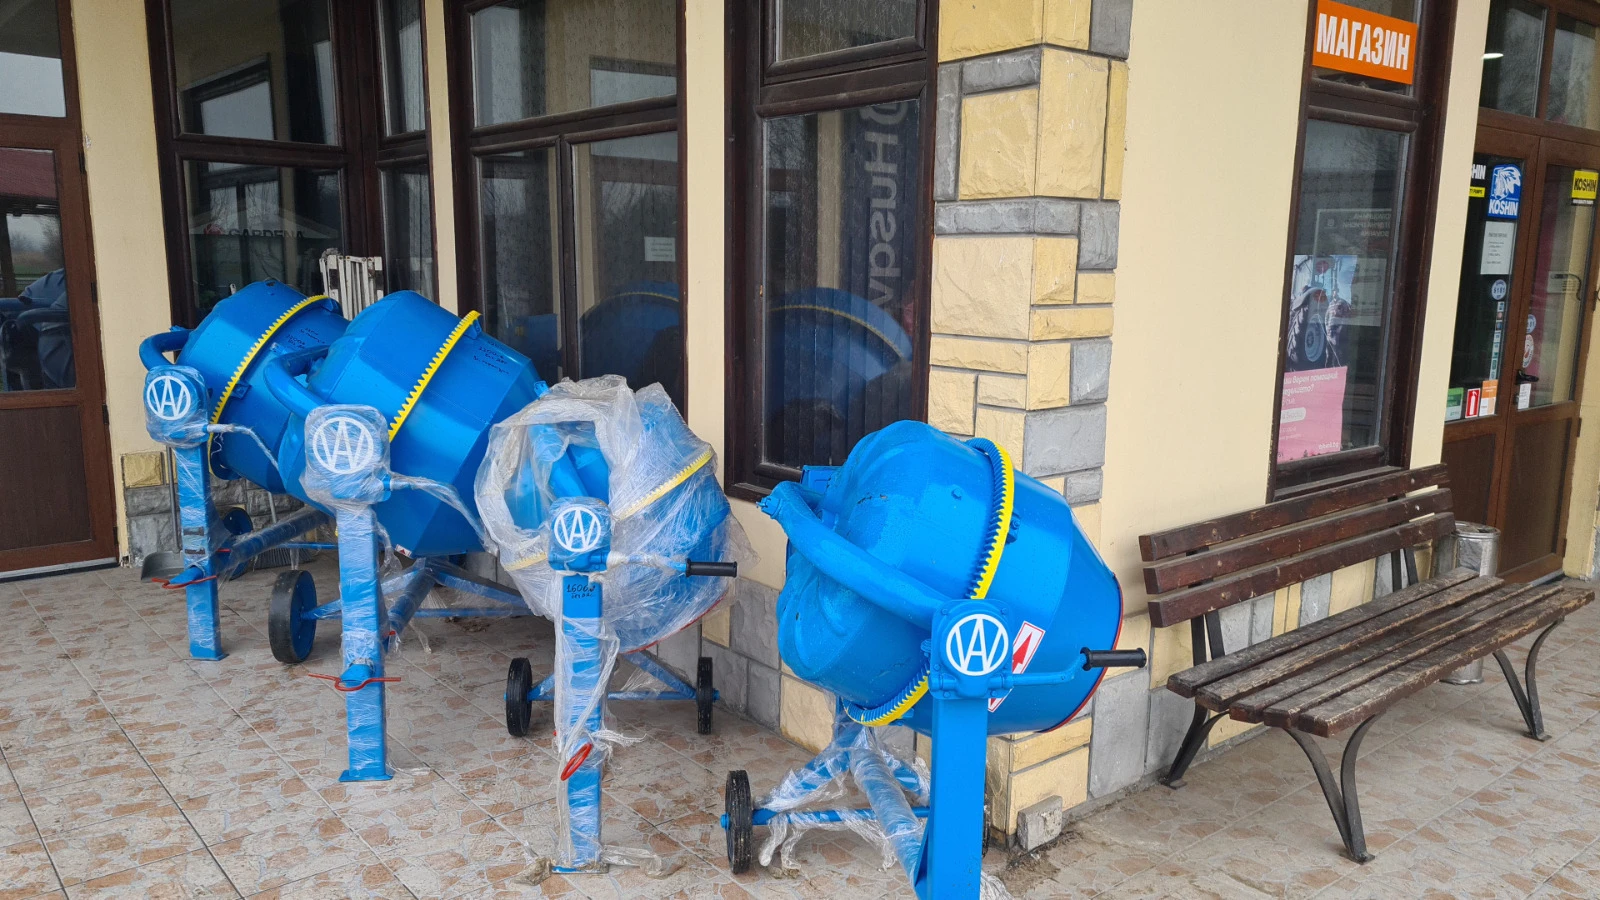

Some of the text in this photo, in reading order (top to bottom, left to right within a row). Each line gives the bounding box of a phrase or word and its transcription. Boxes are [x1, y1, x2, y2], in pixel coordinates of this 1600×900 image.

[1316, 13, 1411, 71] МАГАЗИН
[1471, 163, 1487, 180] HIN
[1573, 177, 1597, 193] KOSHIN
[1488, 199, 1519, 216] KOSHIN
